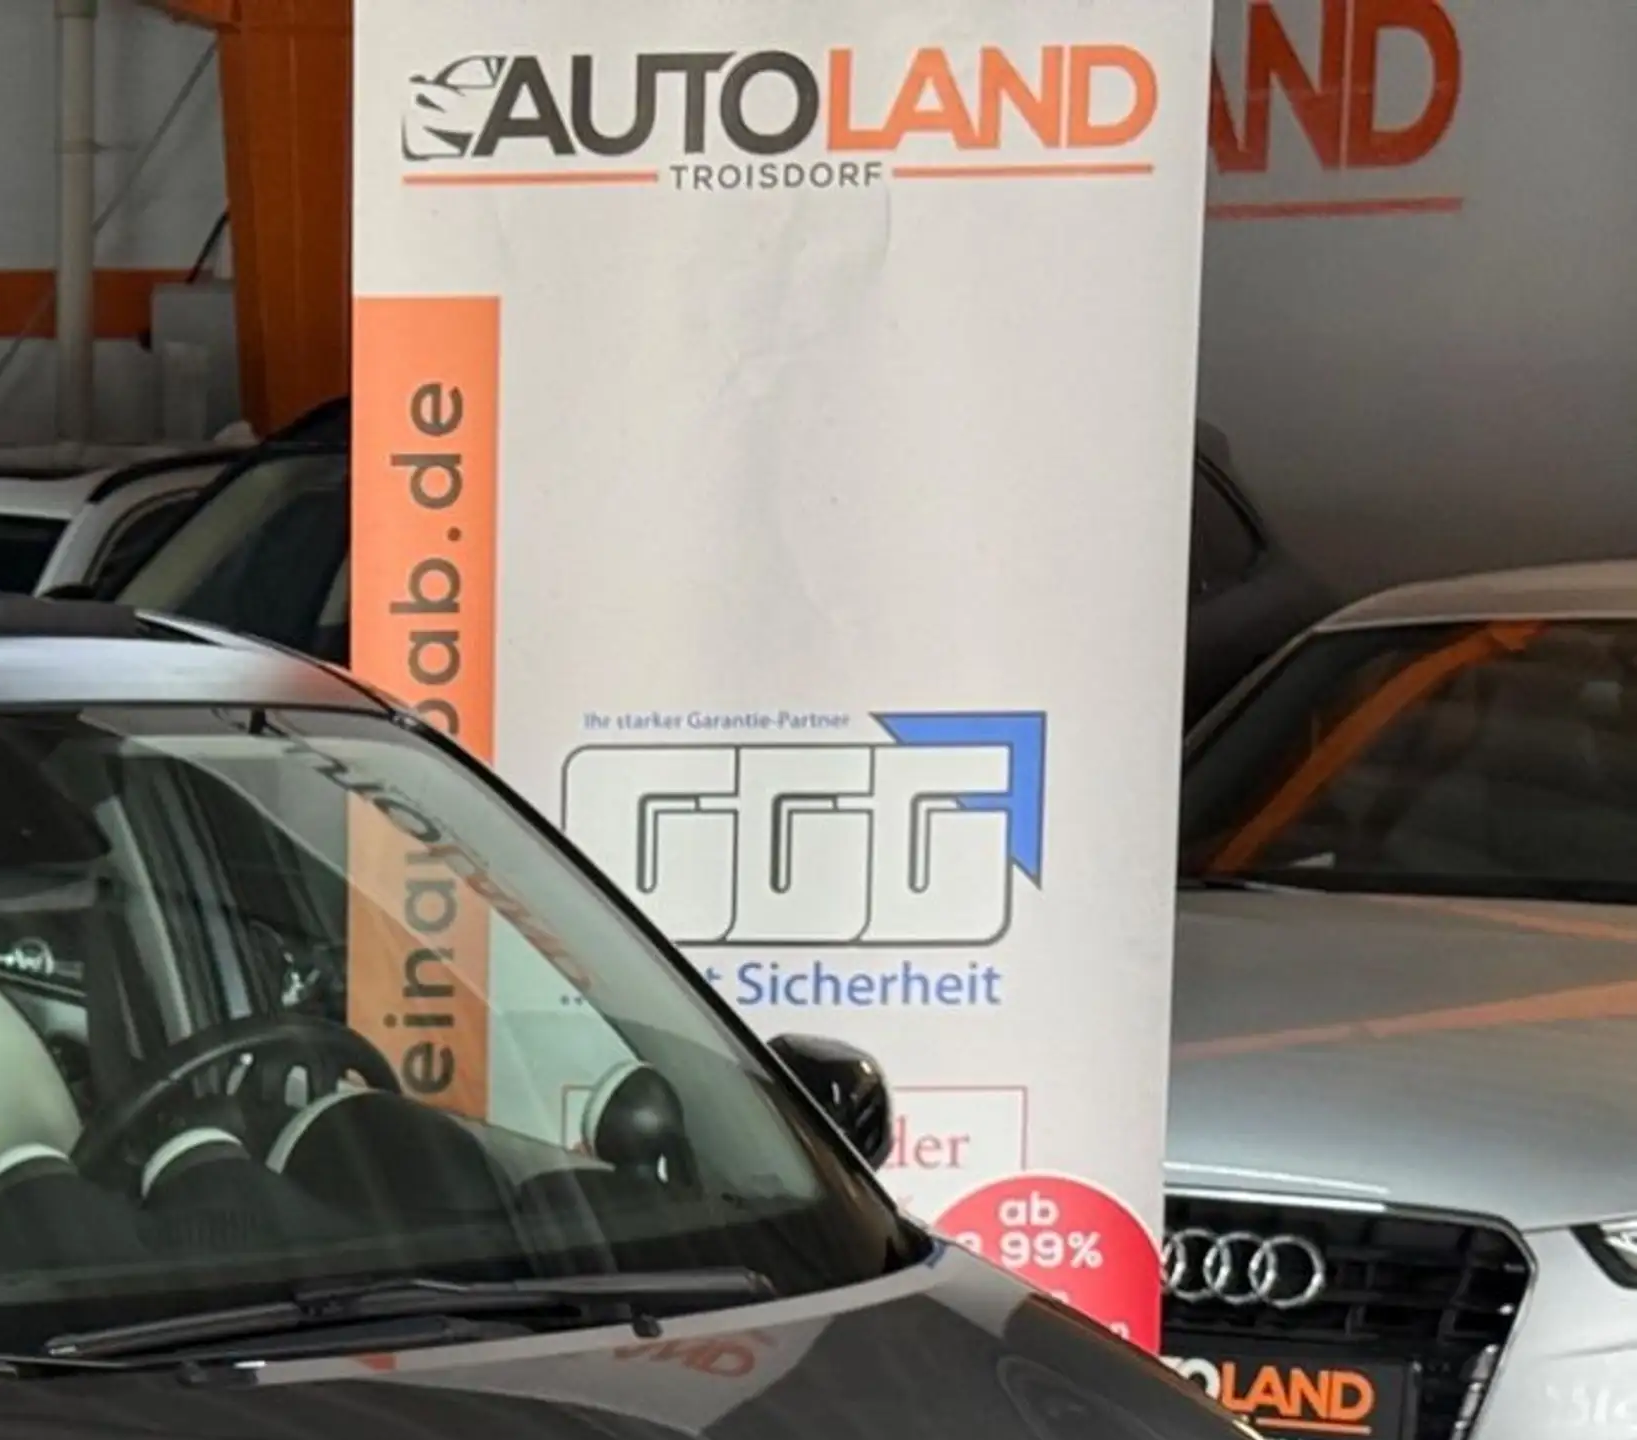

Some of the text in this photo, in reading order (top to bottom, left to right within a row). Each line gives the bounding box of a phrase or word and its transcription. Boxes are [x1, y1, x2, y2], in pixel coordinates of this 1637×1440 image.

[471, 44, 1158, 157] AUTOLAND
[669, 161, 882, 190] TROISDORF
[583, 710, 851, 730] Ihr starker Garantie-Partner
[735, 959, 1002, 1006] Sicherheit
[998, 1190, 1059, 1227] ab
